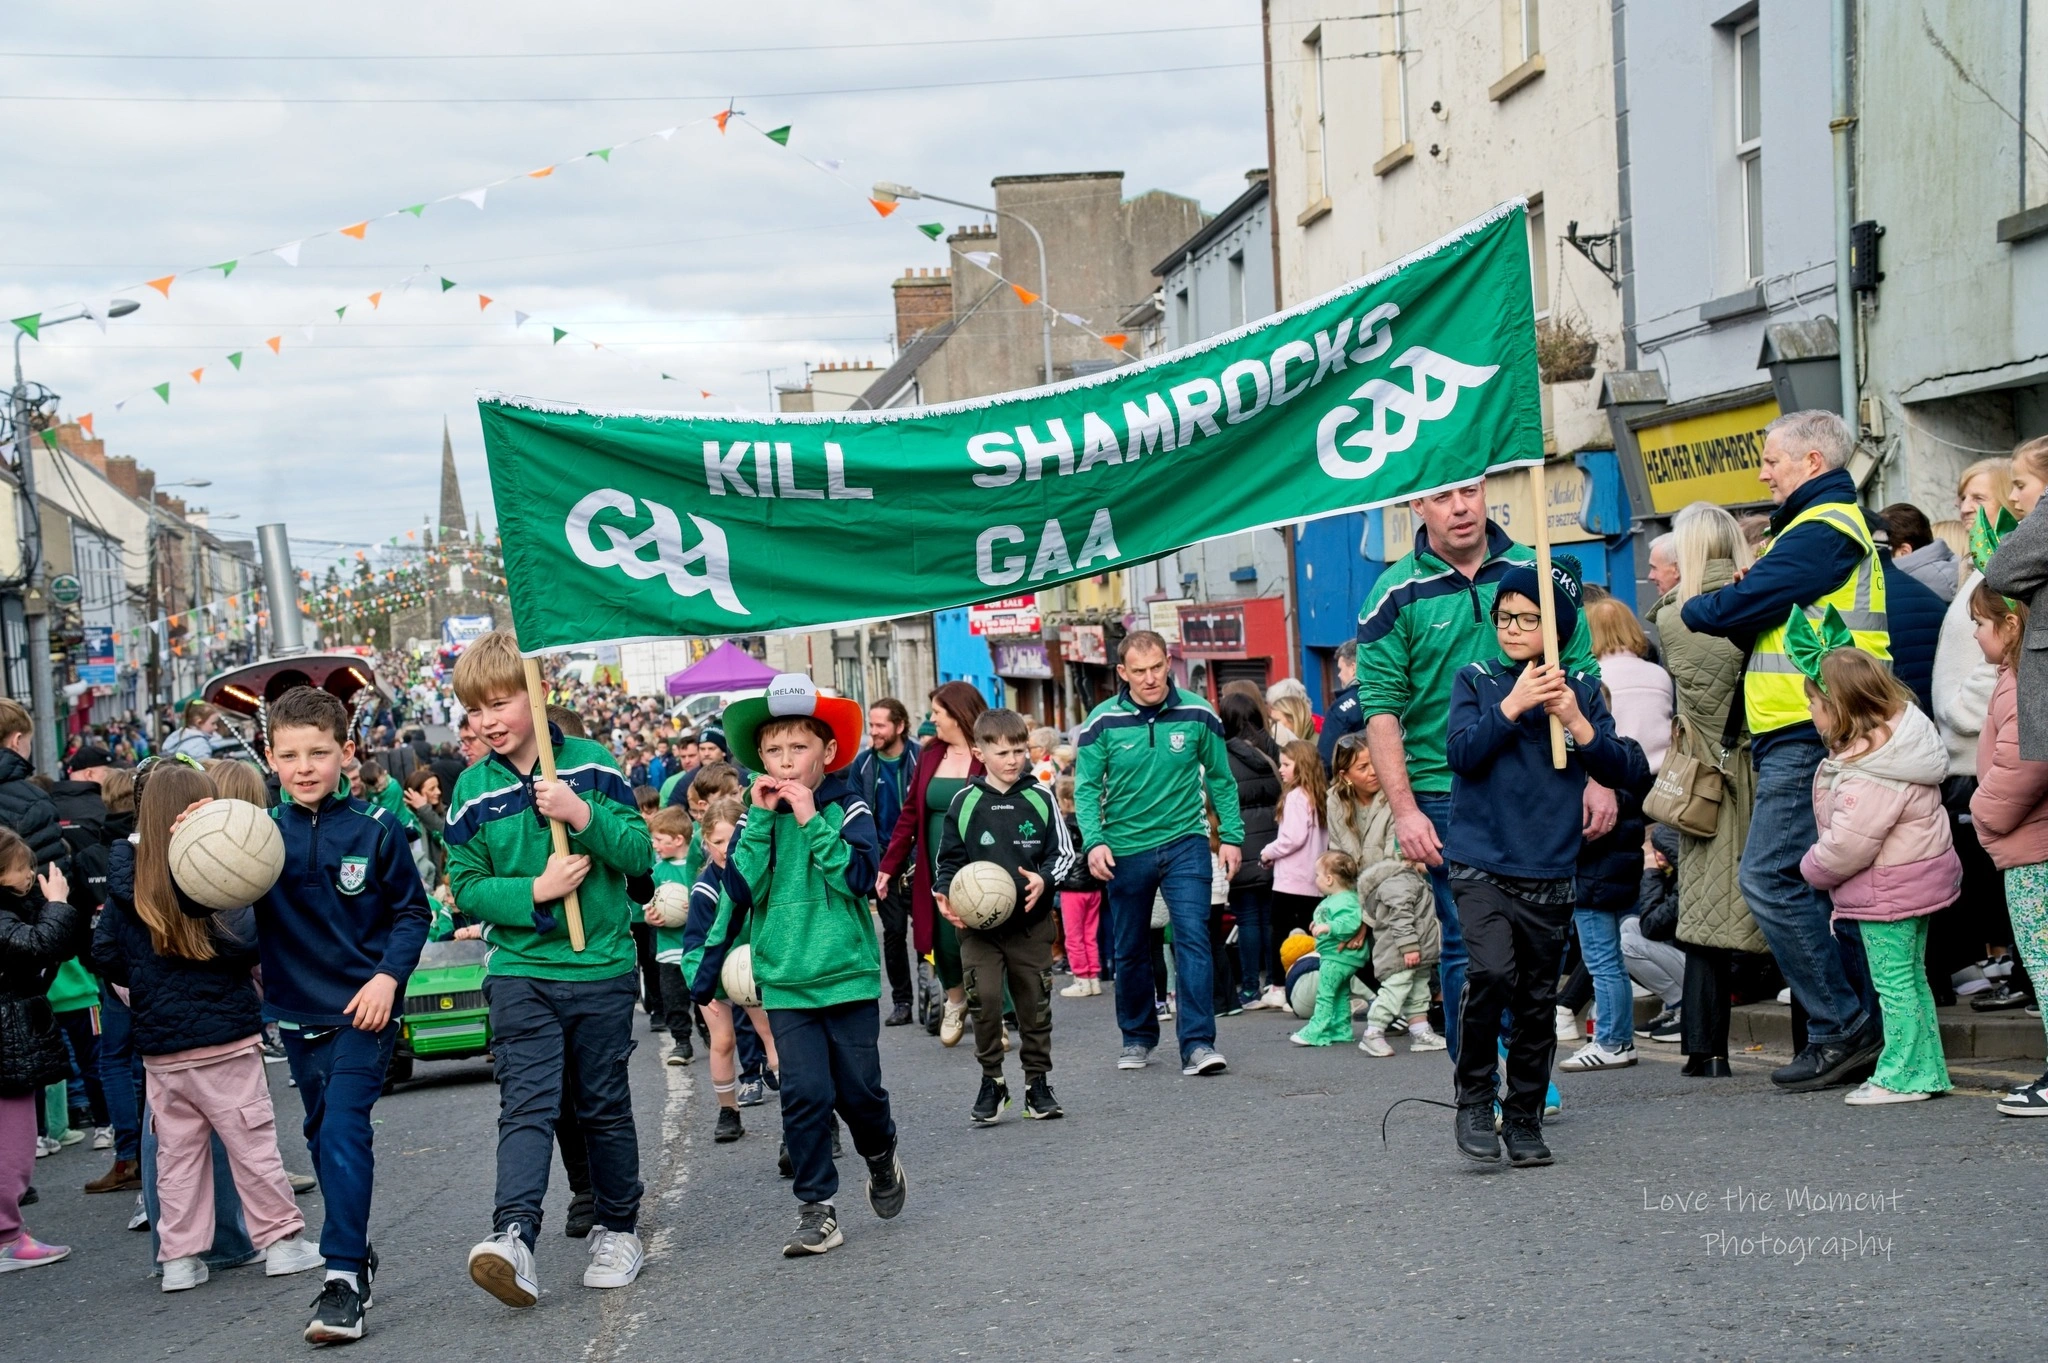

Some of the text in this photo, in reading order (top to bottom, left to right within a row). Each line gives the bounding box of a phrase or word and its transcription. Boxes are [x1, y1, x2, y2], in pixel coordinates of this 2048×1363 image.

[703, 302, 1400, 499] KILL SHAMROCKS
[1643, 444, 1696, 485] HEATHER
[1690, 429, 1762, 477] HUMPHREYS
[976, 508, 1121, 587] GAA
[1003, 598, 1023, 607] SALE
[772, 687, 806, 696] IRELAND
[976, 911, 984, 919] 4
